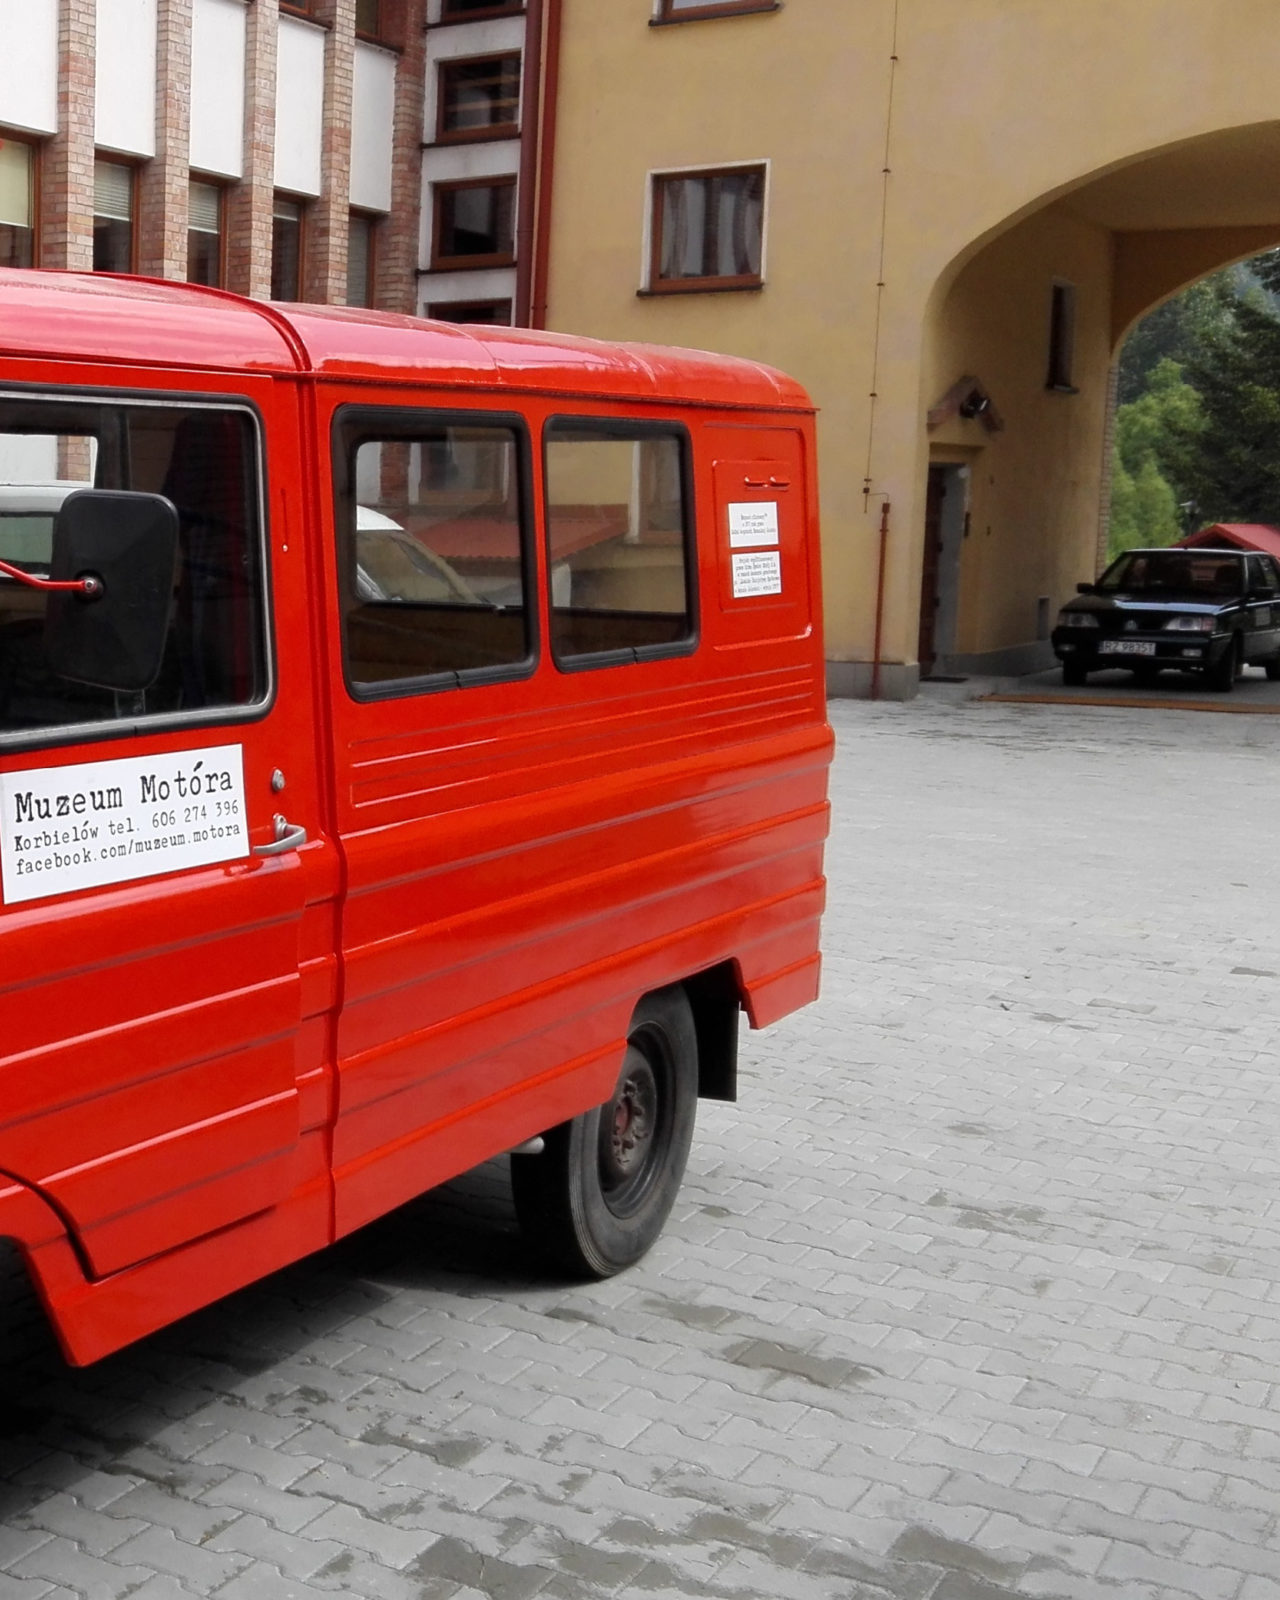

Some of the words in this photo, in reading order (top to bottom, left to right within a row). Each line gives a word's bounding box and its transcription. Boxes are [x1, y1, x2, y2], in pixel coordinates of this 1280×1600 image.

[14, 786, 123, 823] Muzeum
[140, 760, 233, 804] Motóra
[14, 820, 99, 852] Korbielów
[108, 817, 141, 836] tel.
[151, 809, 176, 829] 606
[183, 806, 208, 823] 274
[215, 799, 239, 818] 396
[16, 823, 241, 875] facebook.com/muzeum.motora
